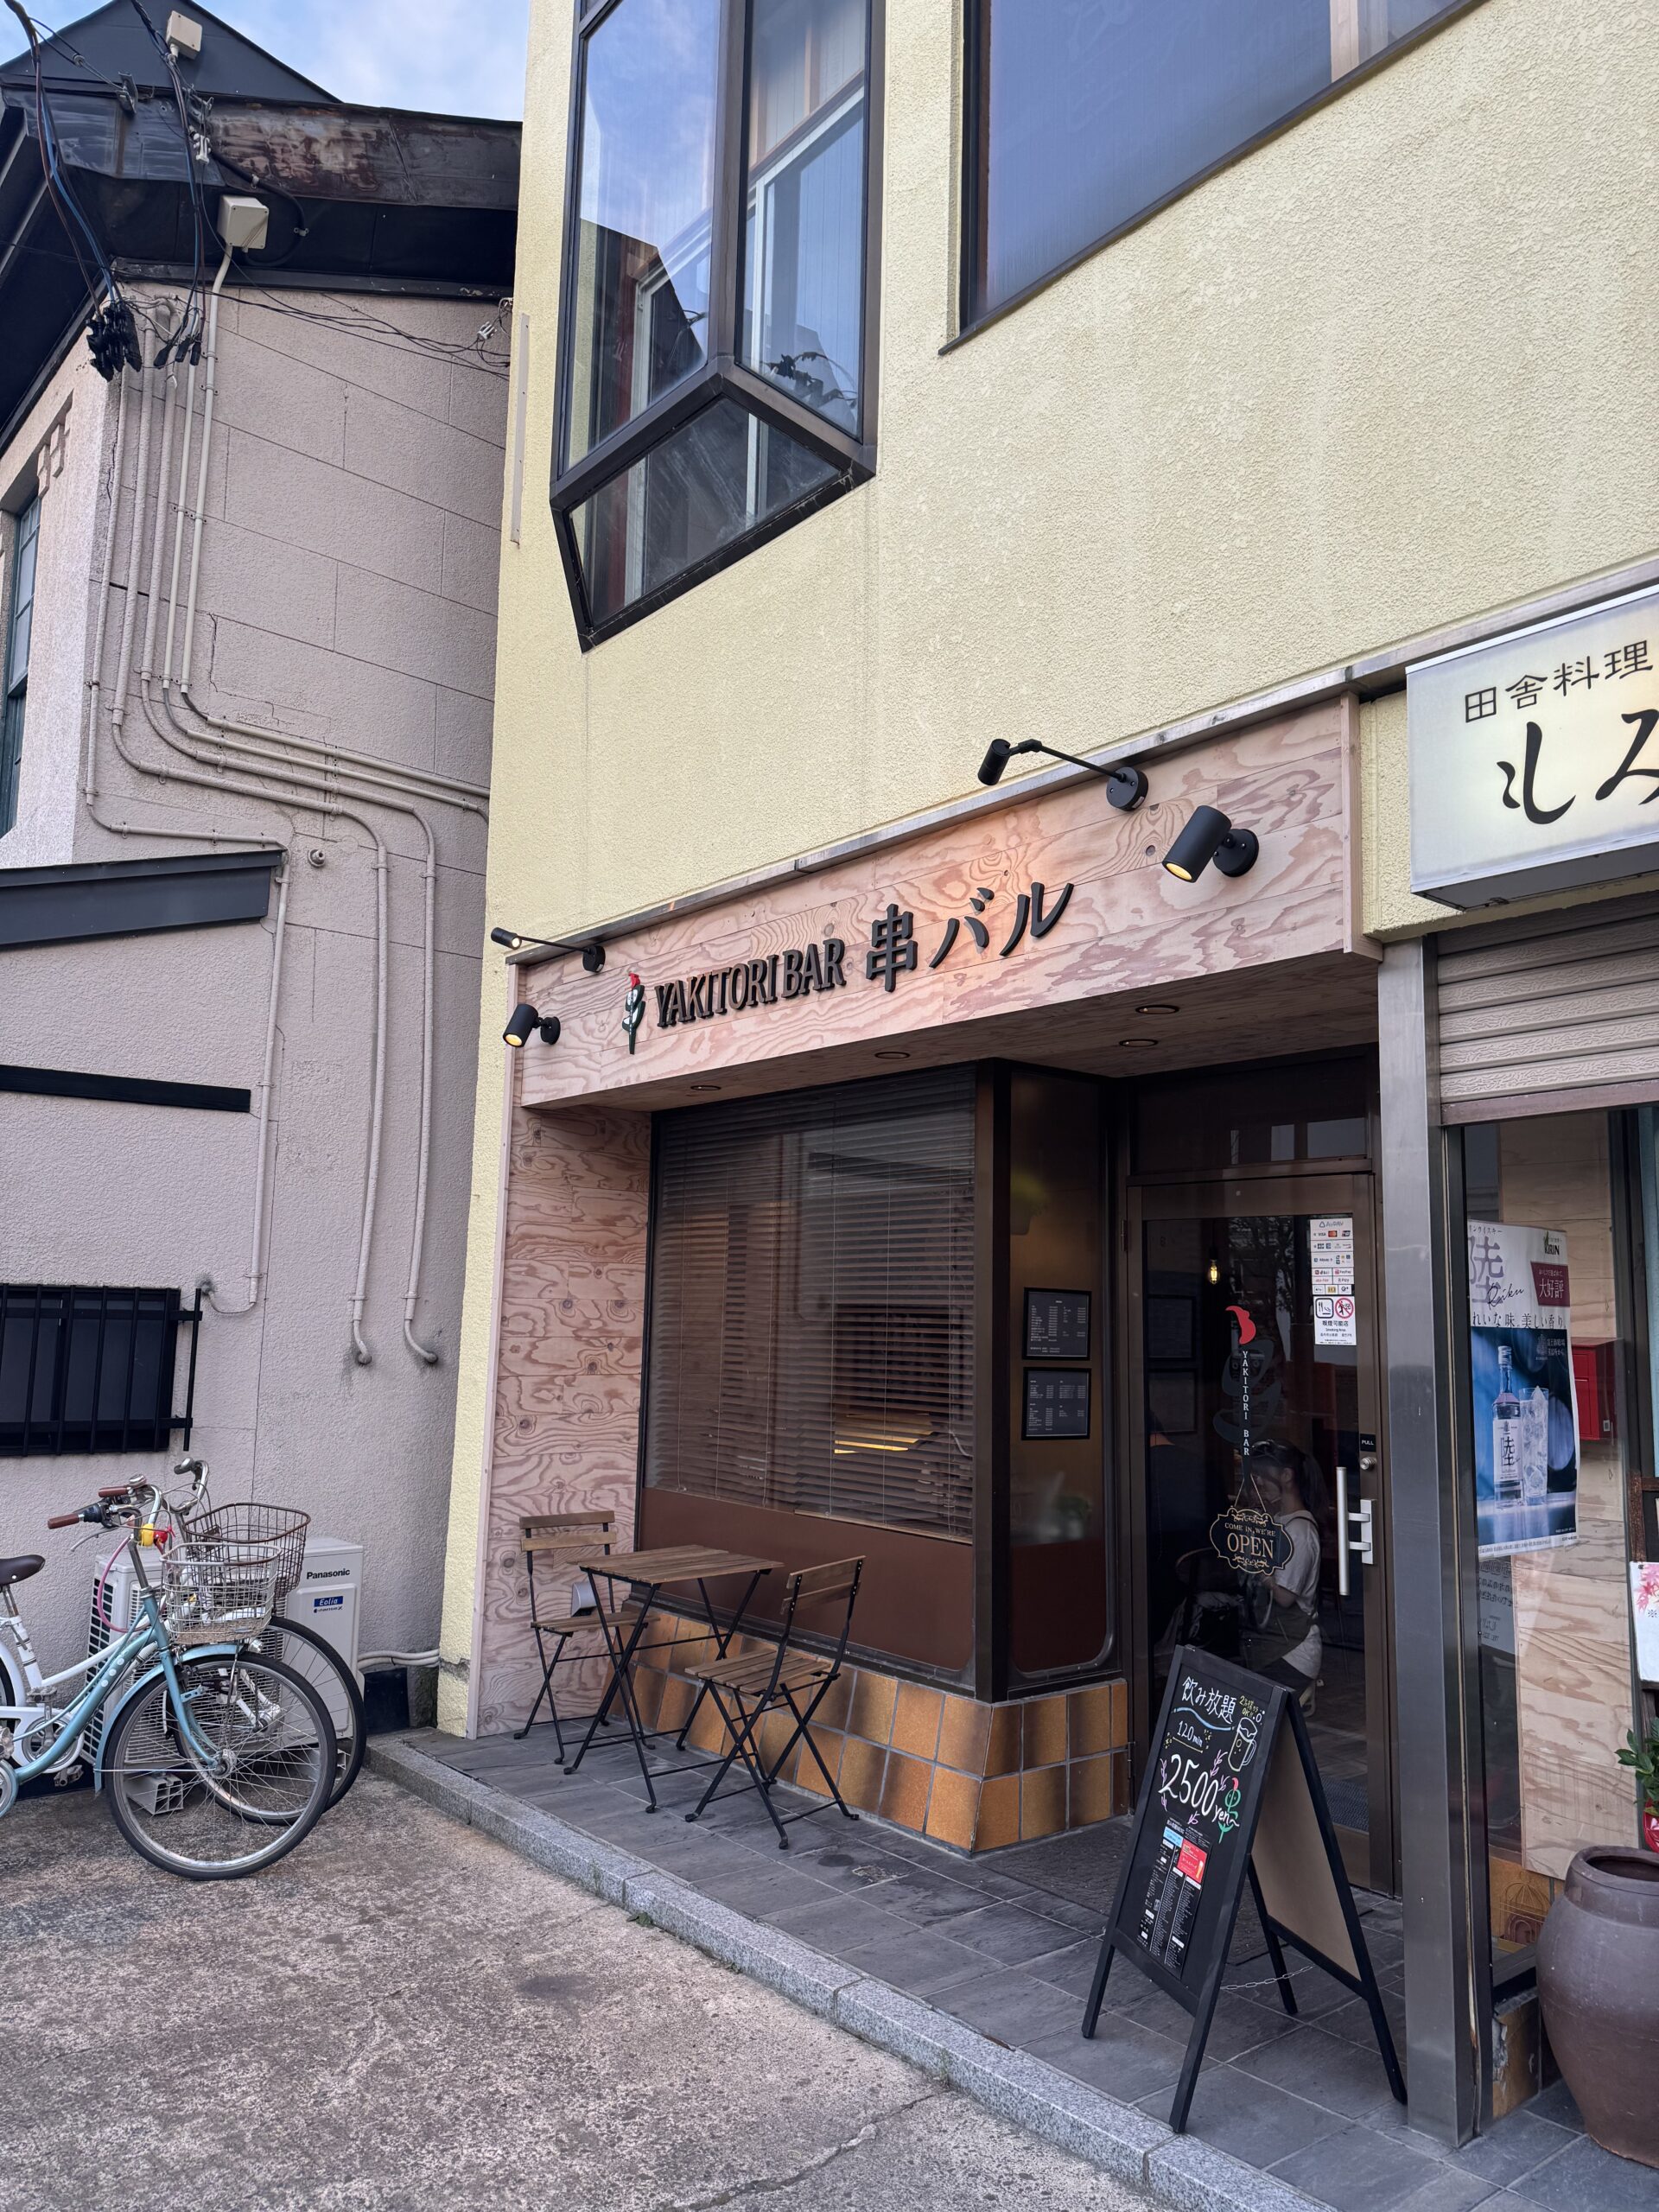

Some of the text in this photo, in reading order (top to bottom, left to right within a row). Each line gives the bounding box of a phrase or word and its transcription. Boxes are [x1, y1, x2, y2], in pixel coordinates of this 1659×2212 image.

[1465, 639, 1654, 723] 田舎料理
[654, 953, 779, 1028] YAKITORI
[780, 938, 847, 1000] BAR
[866, 880, 1075, 993] 串バル
[1544, 1243, 1560, 1255] KIRIN
[1486, 1283, 1524, 1311] Riku
[1538, 1278, 1565, 1299] 大好評
[1224, 1522, 1243, 1531] COME
[1227, 1532, 1274, 1559] OPEN
[307, 1568, 350, 1580] Panasonic
[319, 1598, 339, 1606] Eolia
[1181, 1675, 1237, 1725] 飲み放題
